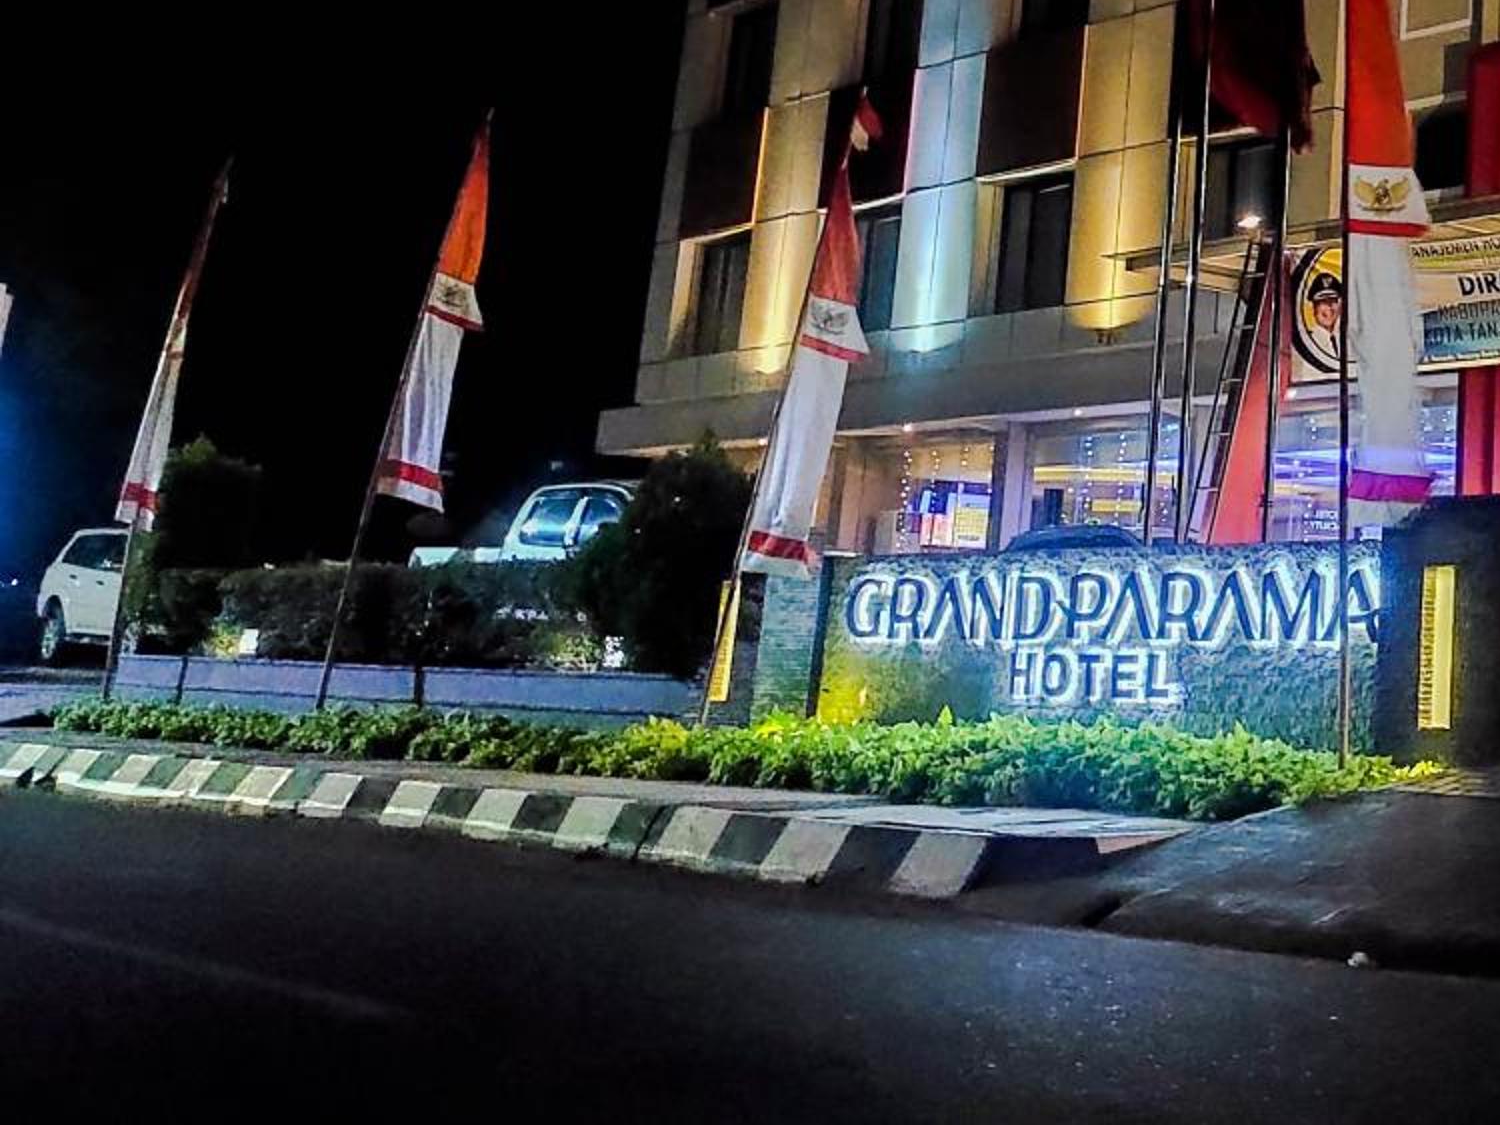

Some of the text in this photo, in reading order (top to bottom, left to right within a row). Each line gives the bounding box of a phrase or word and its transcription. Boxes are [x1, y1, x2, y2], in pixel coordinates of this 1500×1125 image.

[1410, 238, 1479, 259] ANAJEMEN
[846, 568, 1382, 649] GRAND PARAMA
[1007, 650, 1186, 704] HOTEL
